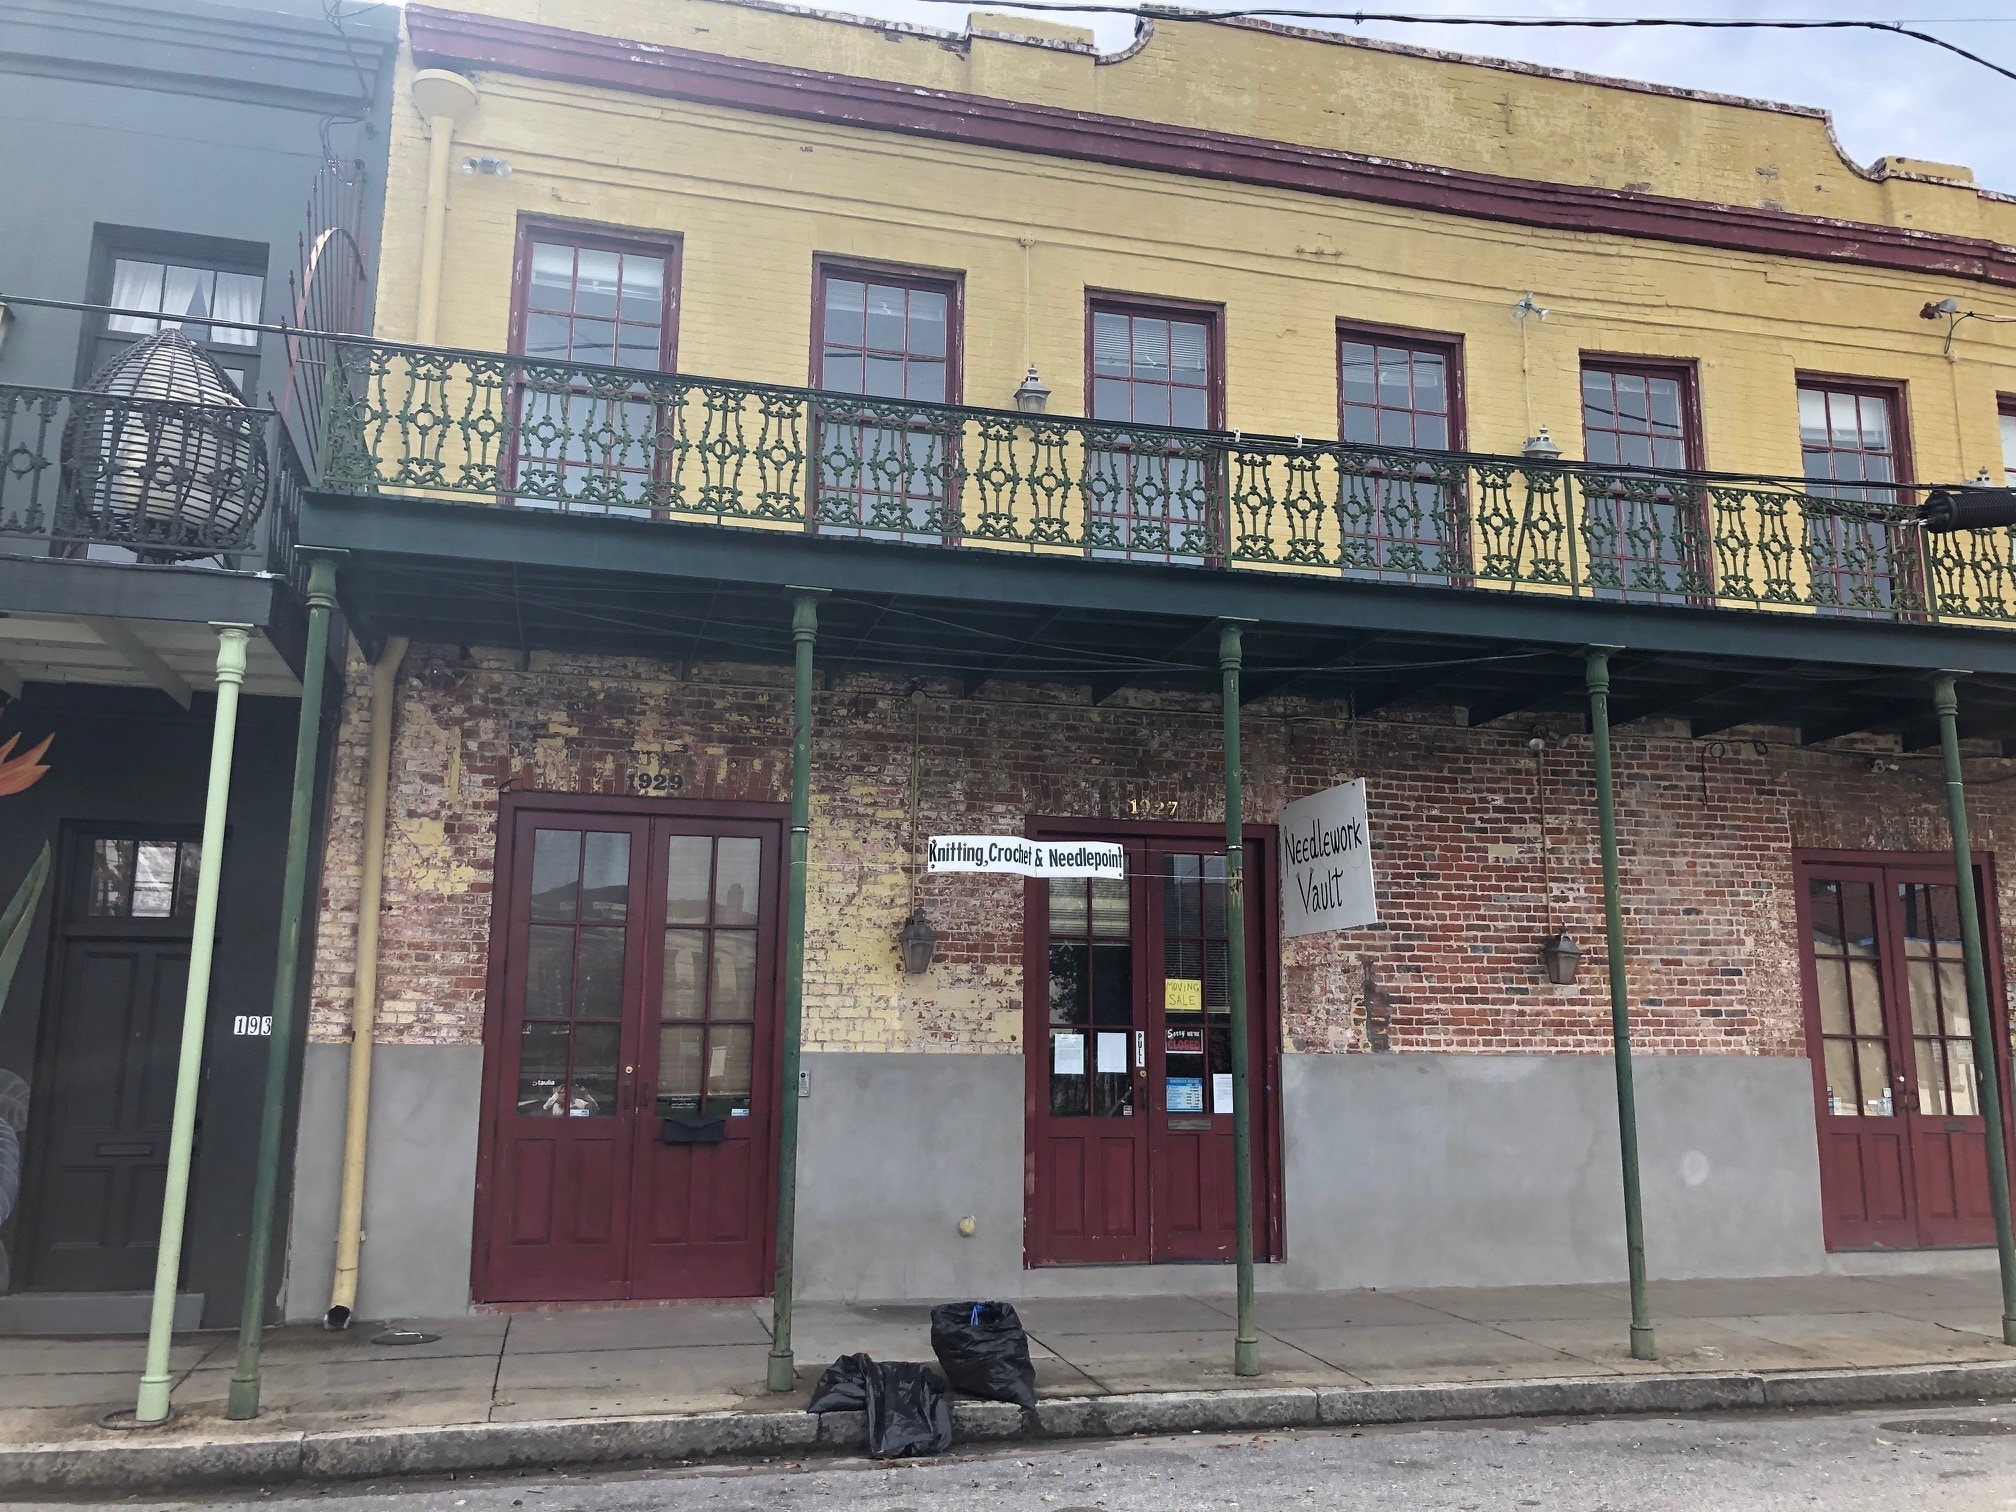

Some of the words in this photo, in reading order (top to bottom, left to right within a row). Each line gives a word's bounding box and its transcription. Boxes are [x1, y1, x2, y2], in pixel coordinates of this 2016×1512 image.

[626, 772, 684, 791] 1929
[1129, 798, 1178, 815] 1927
[1283, 816, 1363, 878] Needlework
[1035, 848, 1043, 868] &
[1049, 846, 1123, 871] Needlepoint
[1296, 866, 1344, 916] Vault
[1169, 994, 1196, 1007] SALE
[1167, 1028, 1185, 1038] Sorry
[1167, 1040, 1200, 1050] CLOSED
